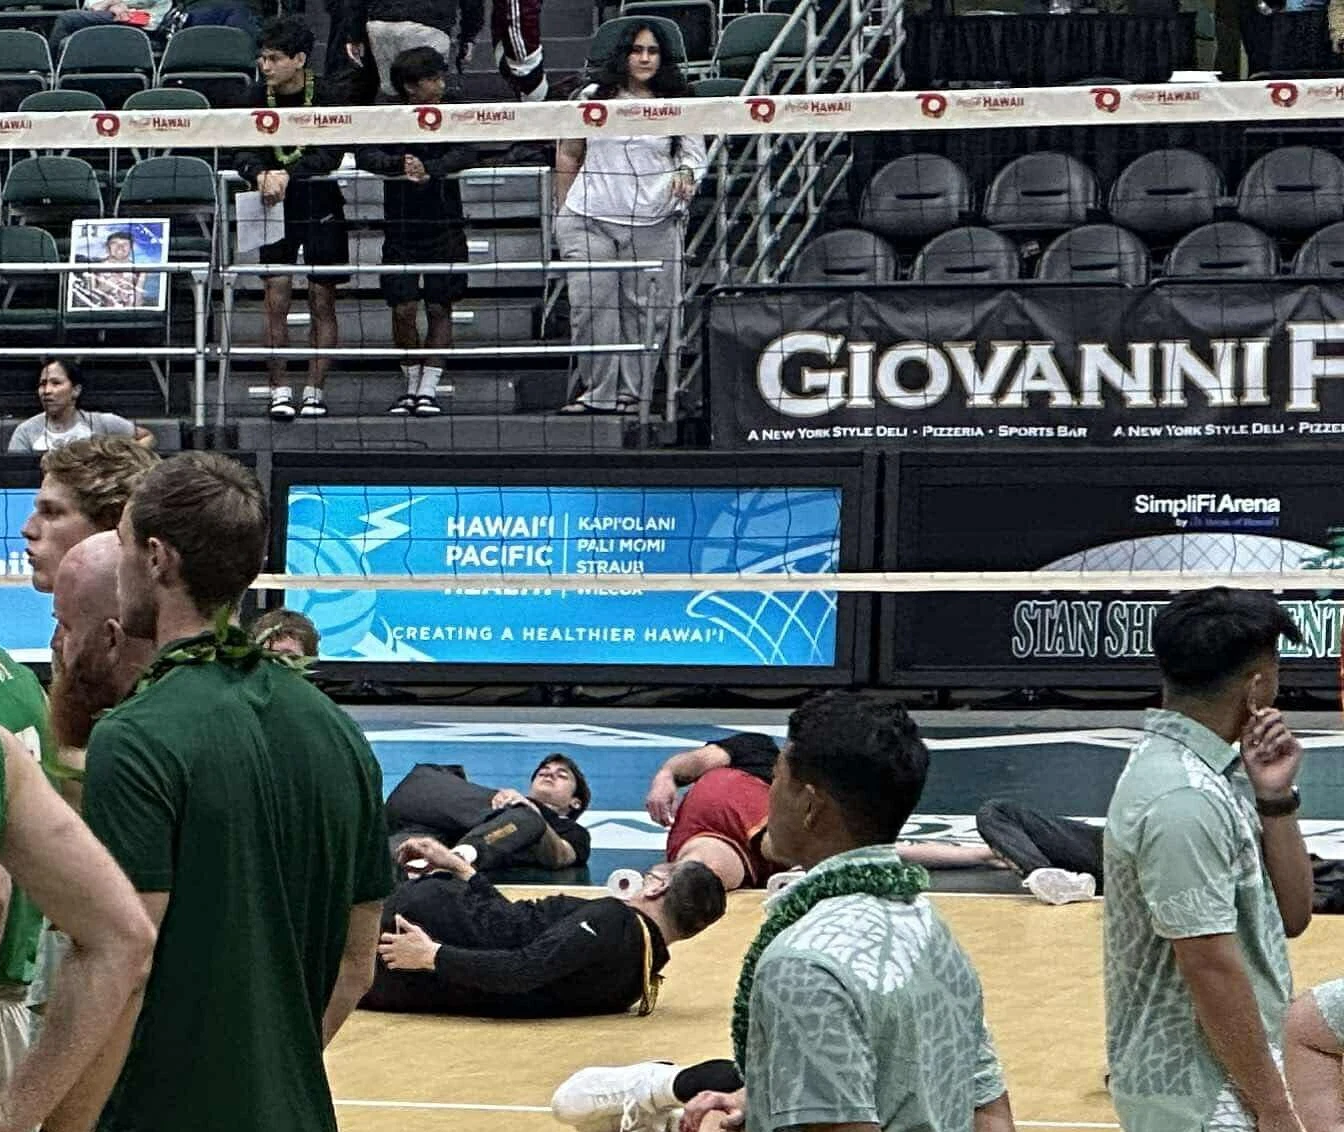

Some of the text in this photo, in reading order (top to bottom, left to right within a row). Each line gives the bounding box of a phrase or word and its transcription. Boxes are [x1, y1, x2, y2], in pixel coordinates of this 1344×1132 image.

[756, 331, 1271, 416] GIOVANNI
[747, 425, 1088, 441] A NEW YORK STYLE DELI PIZZERIA SPORTS BAR
[1113, 422, 1344, 437] A NEW YORK STYLE DELI PIZZE
[1135, 494, 1280, 517] SimpliFi Arena
[578, 540, 665, 553] PALI MOMI
[446, 545, 553, 567] PACIFIC
[576, 560, 645, 574] STRAUB
[393, 626, 494, 642] CREATING
[500, 626, 514, 641] A
[522, 626, 636, 642] HEALTHIER
[1012, 600, 1102, 658] STAN
